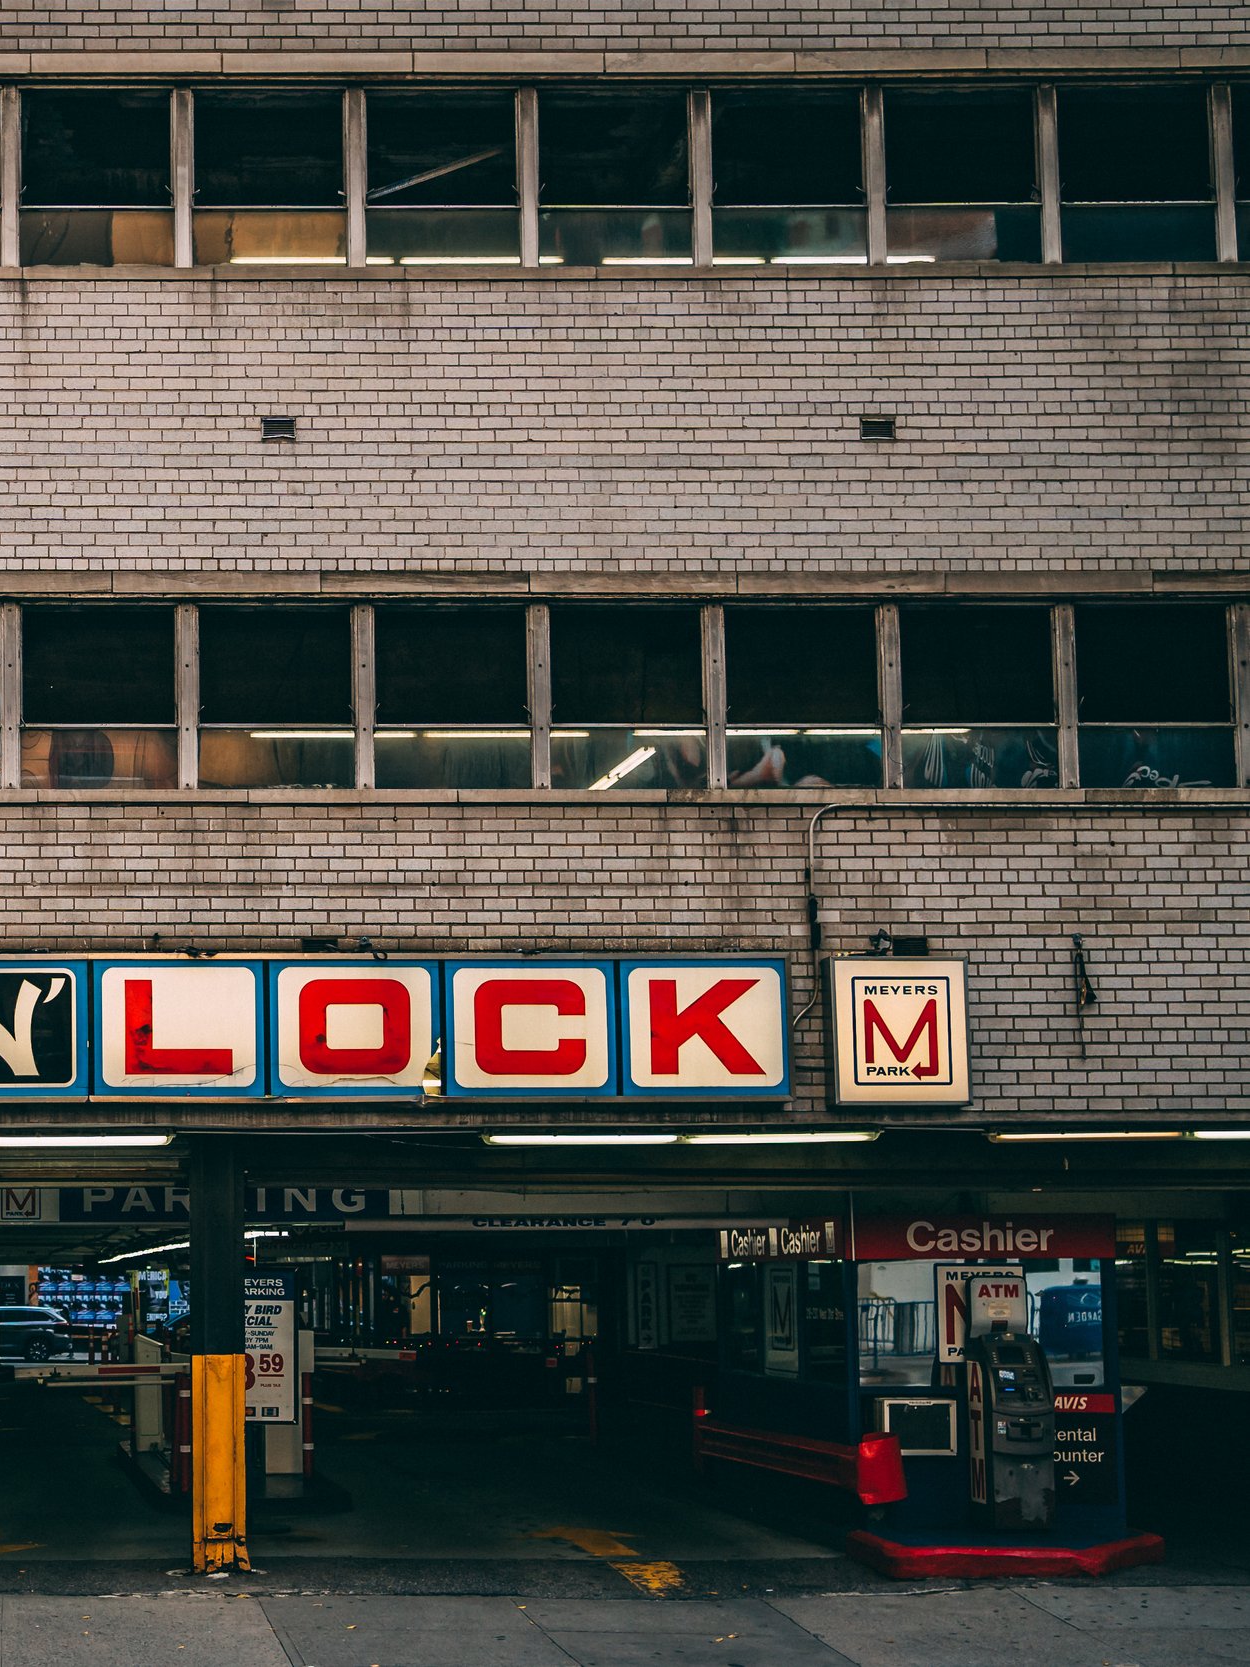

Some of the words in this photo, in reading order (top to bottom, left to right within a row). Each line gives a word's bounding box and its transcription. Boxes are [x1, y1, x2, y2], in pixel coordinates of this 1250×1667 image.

[863, 984, 938, 995] MEYERS
[123, 978, 766, 1076] LOCK
[865, 1065, 911, 1077] PARK
[83, 1187, 367, 1213] PARING
[472, 1216, 606, 1227] CLEARANCE
[731, 1229, 766, 1256] Cashier
[780, 1226, 821, 1254] Cashier
[906, 1221, 1054, 1252] Cashier
[978, 1284, 1019, 1298] ATM
[254, 1305, 282, 1315] BIRD
[641, 1279, 654, 1331] PARK
[245, 1316, 272, 1325] CIAL
[947, 1347, 965, 1357] PA
[259, 1354, 284, 1373] 59
[1054, 1396, 1088, 1410] AVIS
[970, 1362, 986, 1500] ATM
[1053, 1426, 1097, 1442] ental
[1053, 1450, 1105, 1463] ounter
